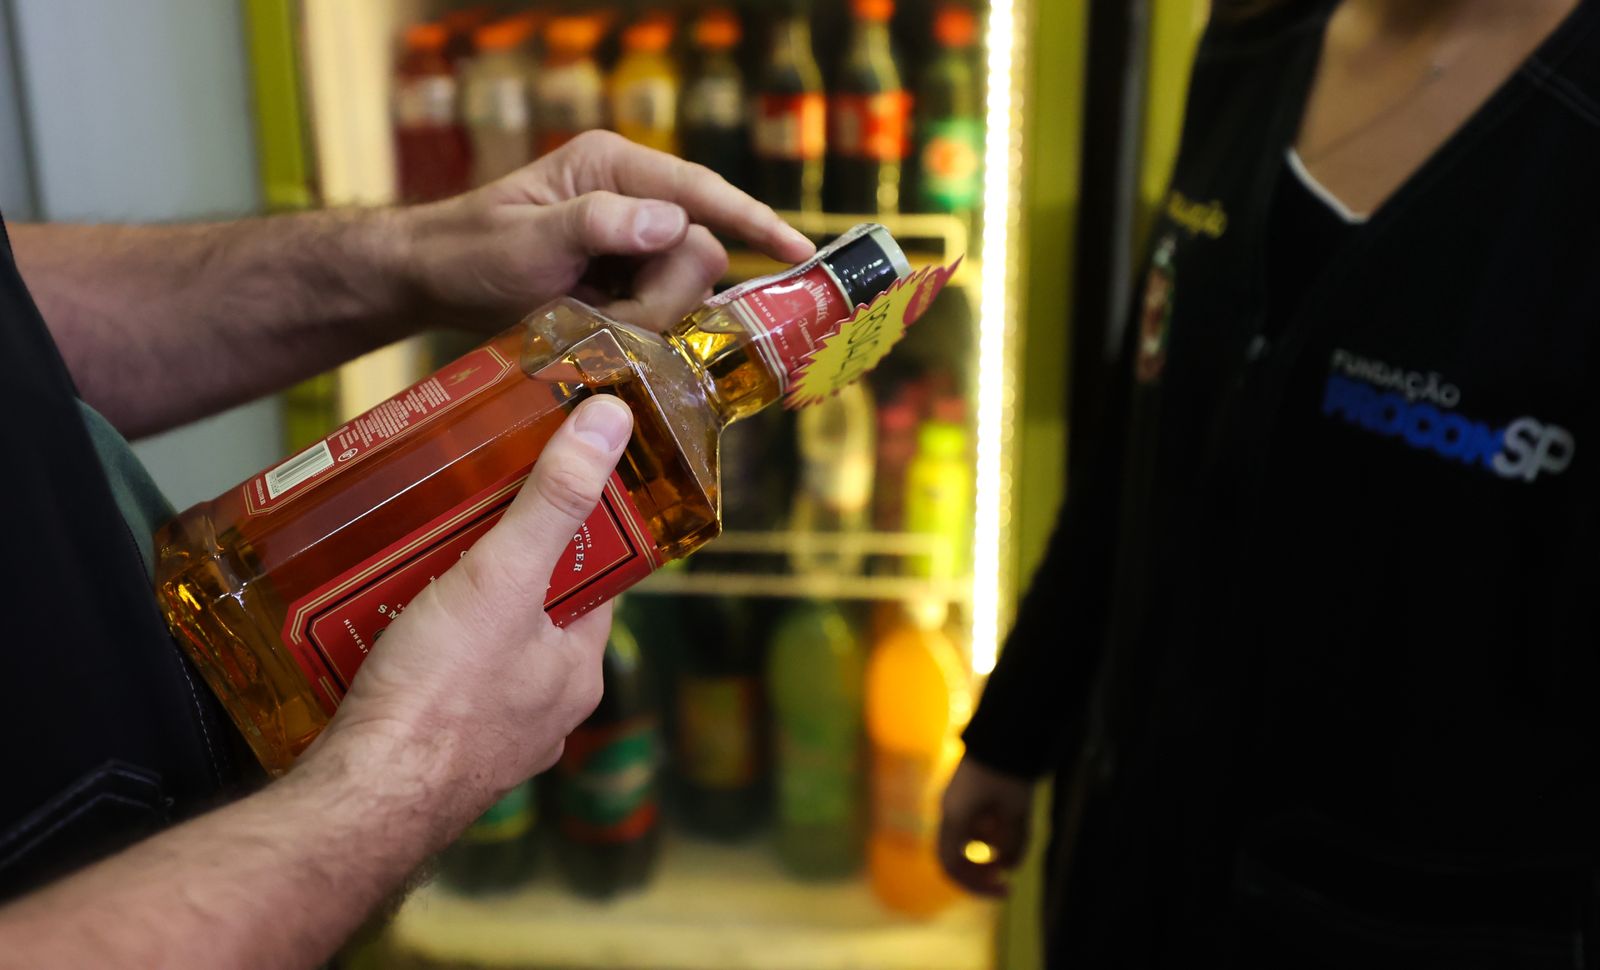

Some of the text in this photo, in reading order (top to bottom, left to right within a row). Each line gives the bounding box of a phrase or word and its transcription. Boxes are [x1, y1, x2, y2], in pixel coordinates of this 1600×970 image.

[1332, 349, 1461, 408] FUNDAÇÃO
[573, 533, 585, 572] CTER
[378, 604, 400, 620] SM
[344, 619, 369, 655] HIGHEST
